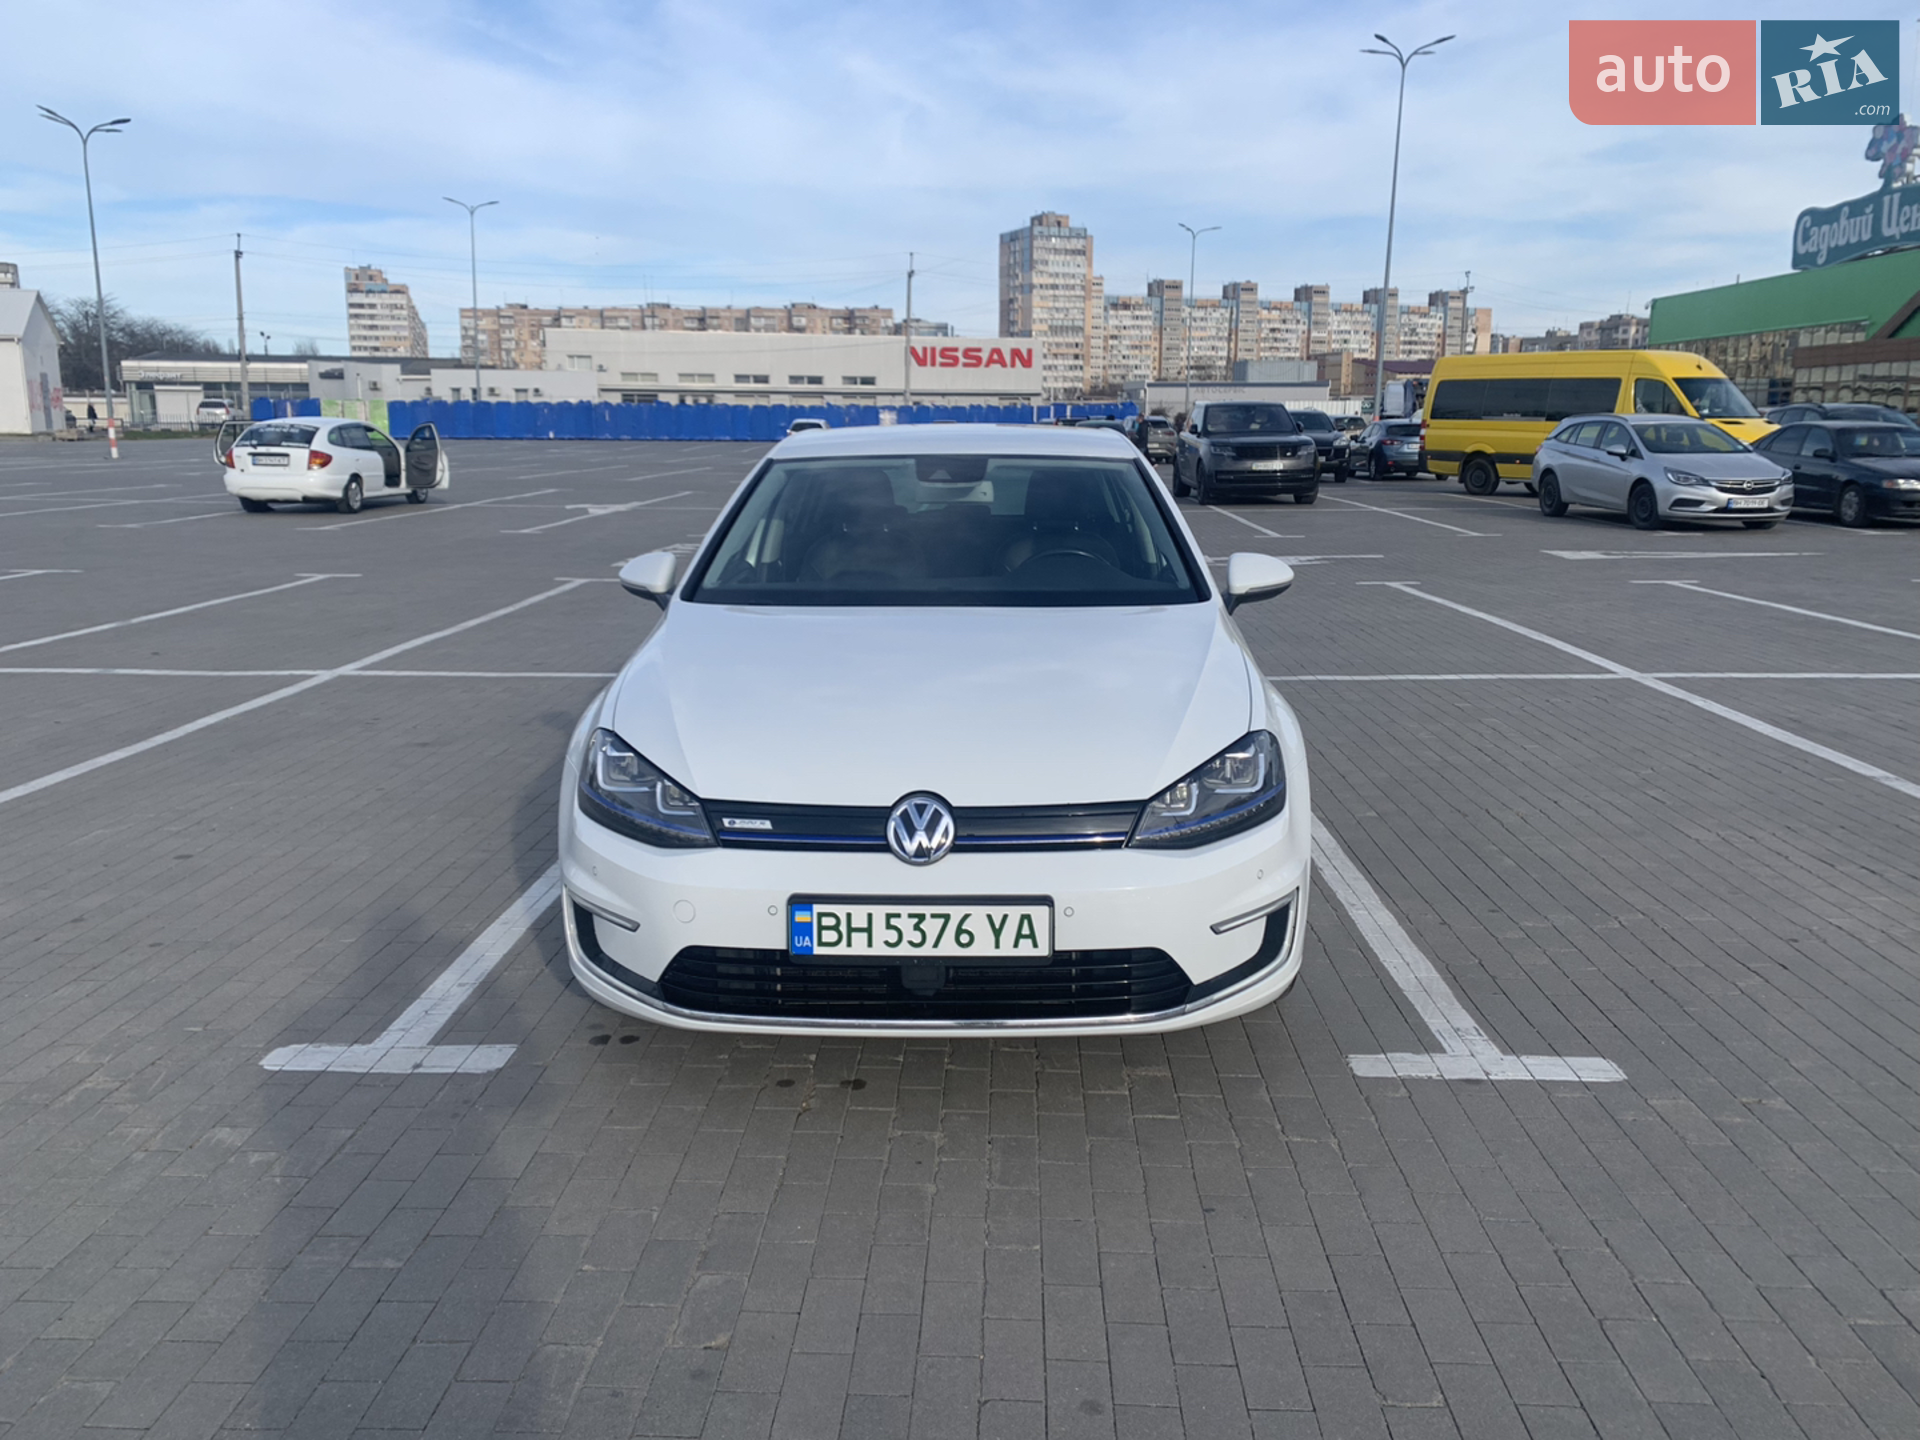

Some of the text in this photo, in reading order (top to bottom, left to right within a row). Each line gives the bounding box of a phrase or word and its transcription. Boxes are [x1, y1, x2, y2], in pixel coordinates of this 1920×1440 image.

[1796, 203, 1874, 265] Садовий
[909, 346, 1033, 368] NISSAN
[794, 936, 812, 948] UA
[816, 911, 1039, 949] BH 5376 YA
